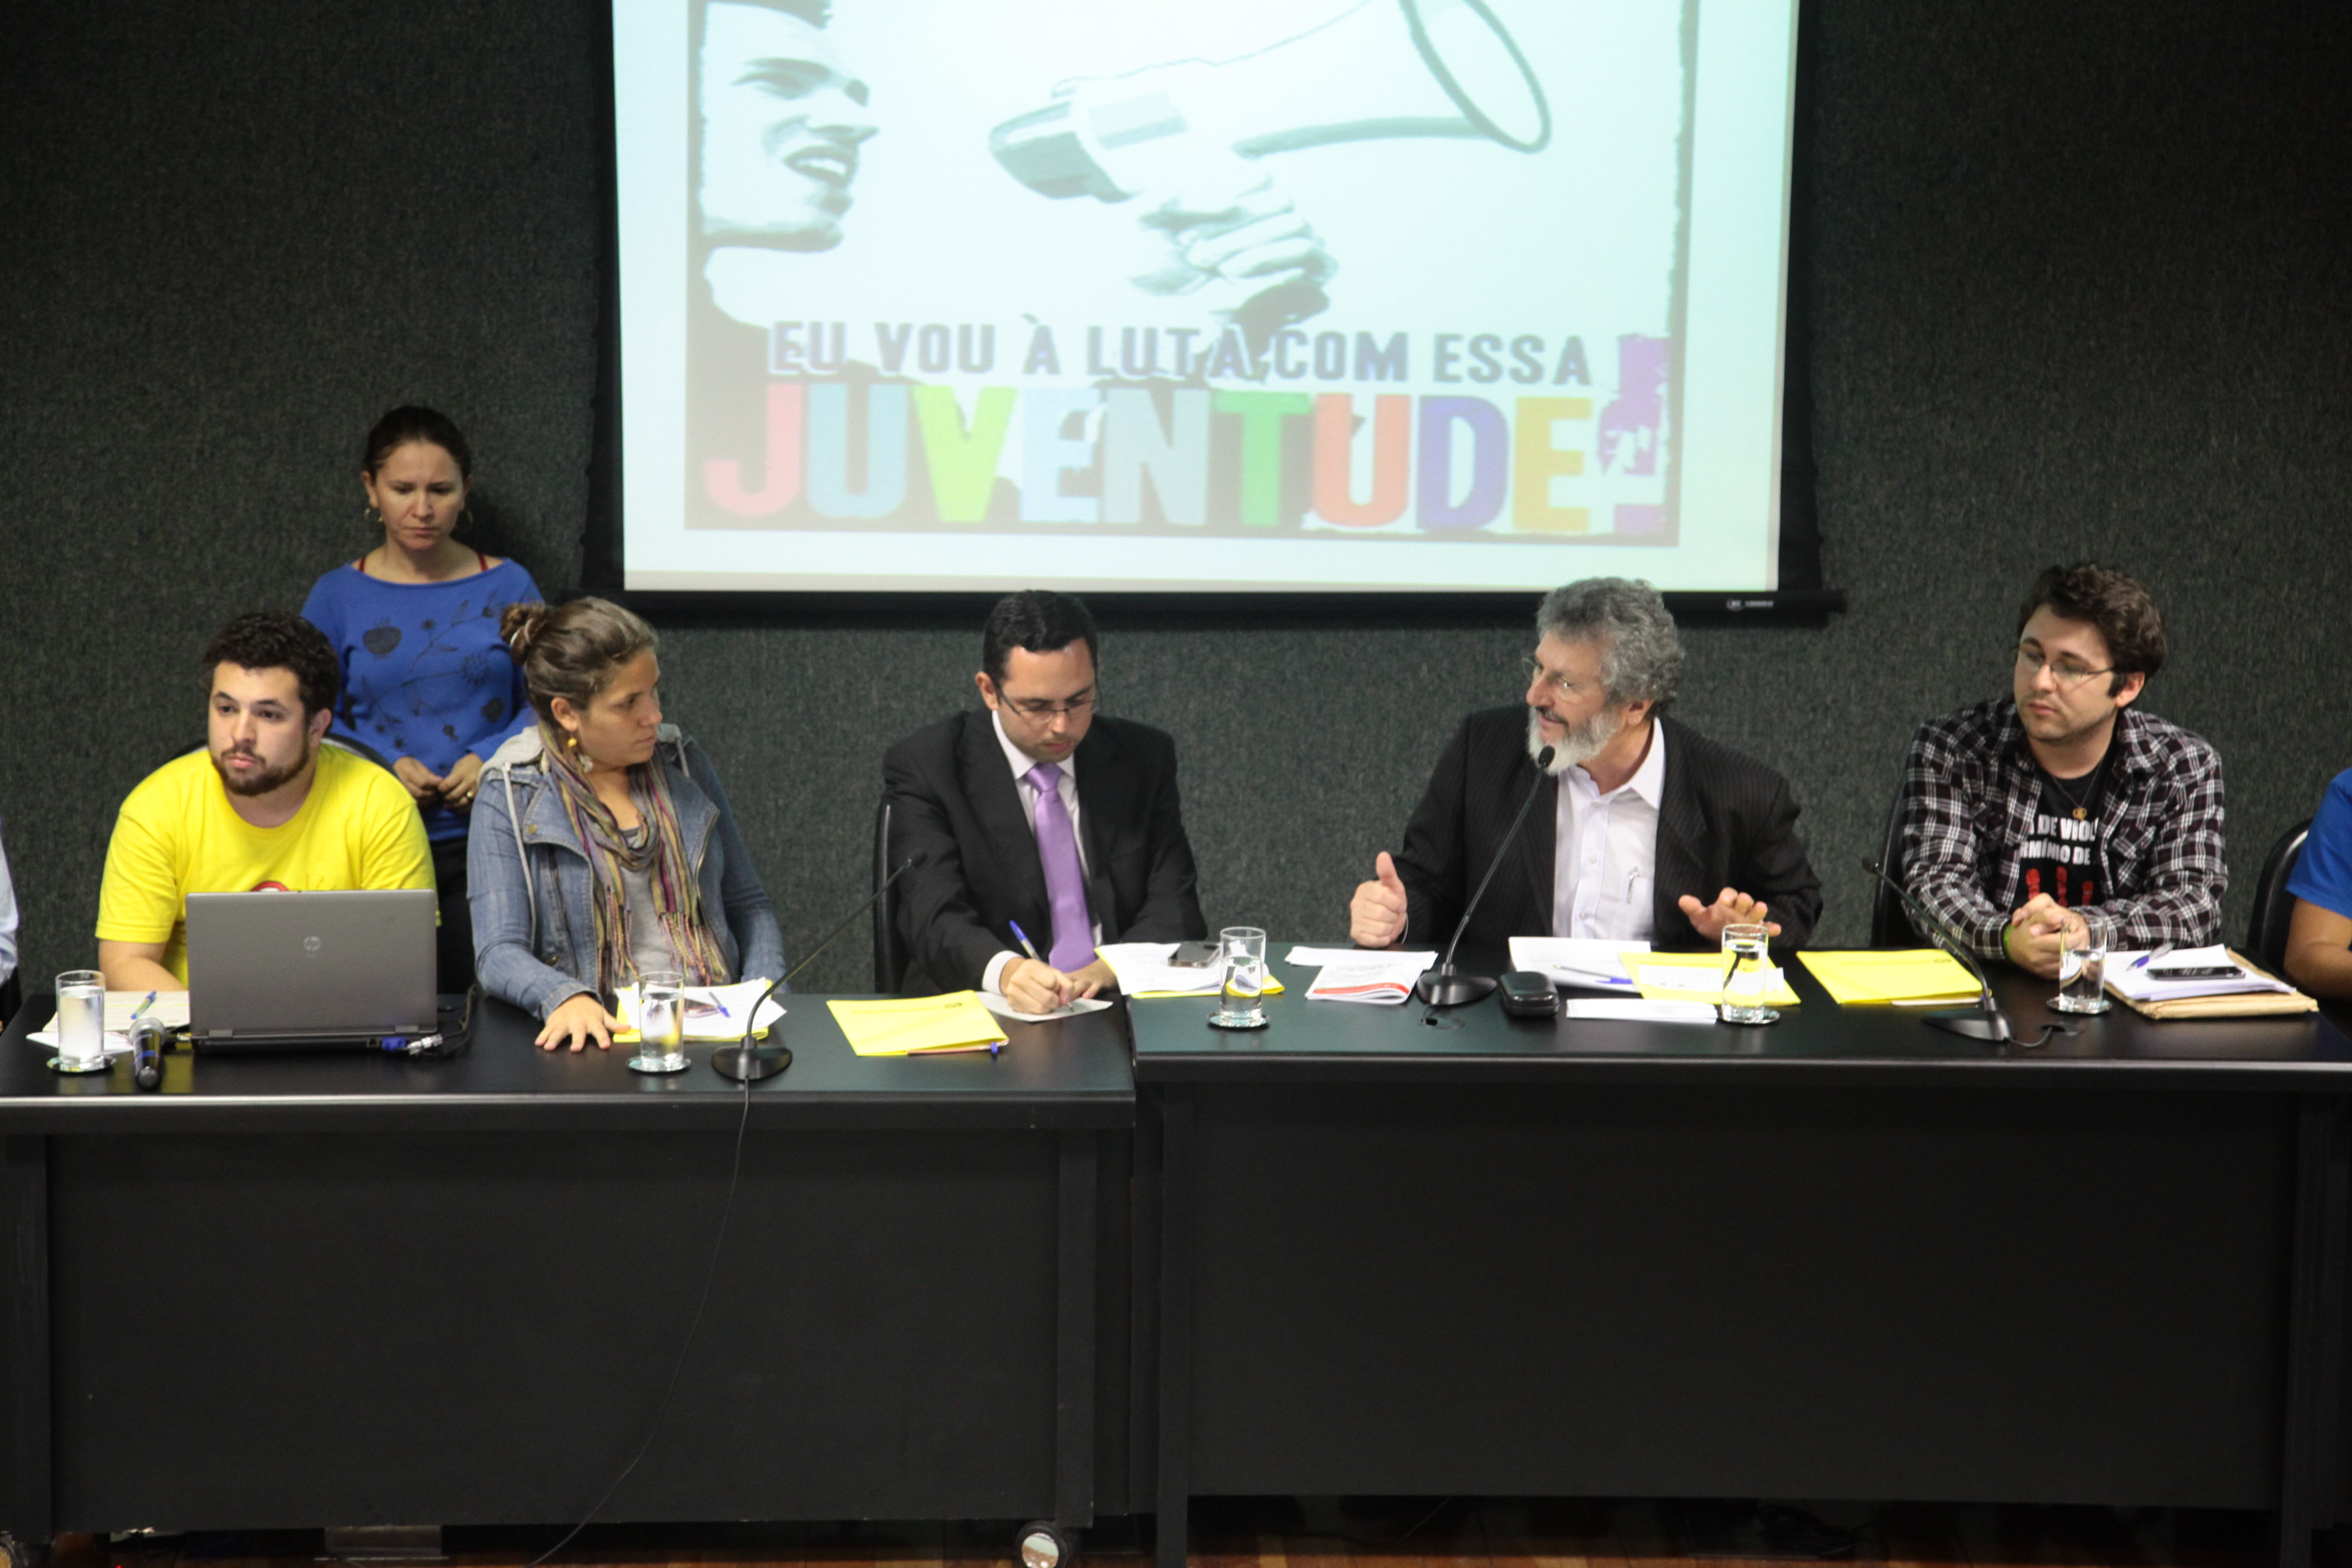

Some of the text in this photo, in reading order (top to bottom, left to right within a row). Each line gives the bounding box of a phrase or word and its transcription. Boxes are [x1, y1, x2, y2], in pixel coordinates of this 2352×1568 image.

[773, 313, 1592, 386] EU VOU À LUTA COM ESSA
[2037, 814, 2057, 836] DE
[2060, 817, 2099, 842] VIOL
[2072, 846, 2091, 865] DE
